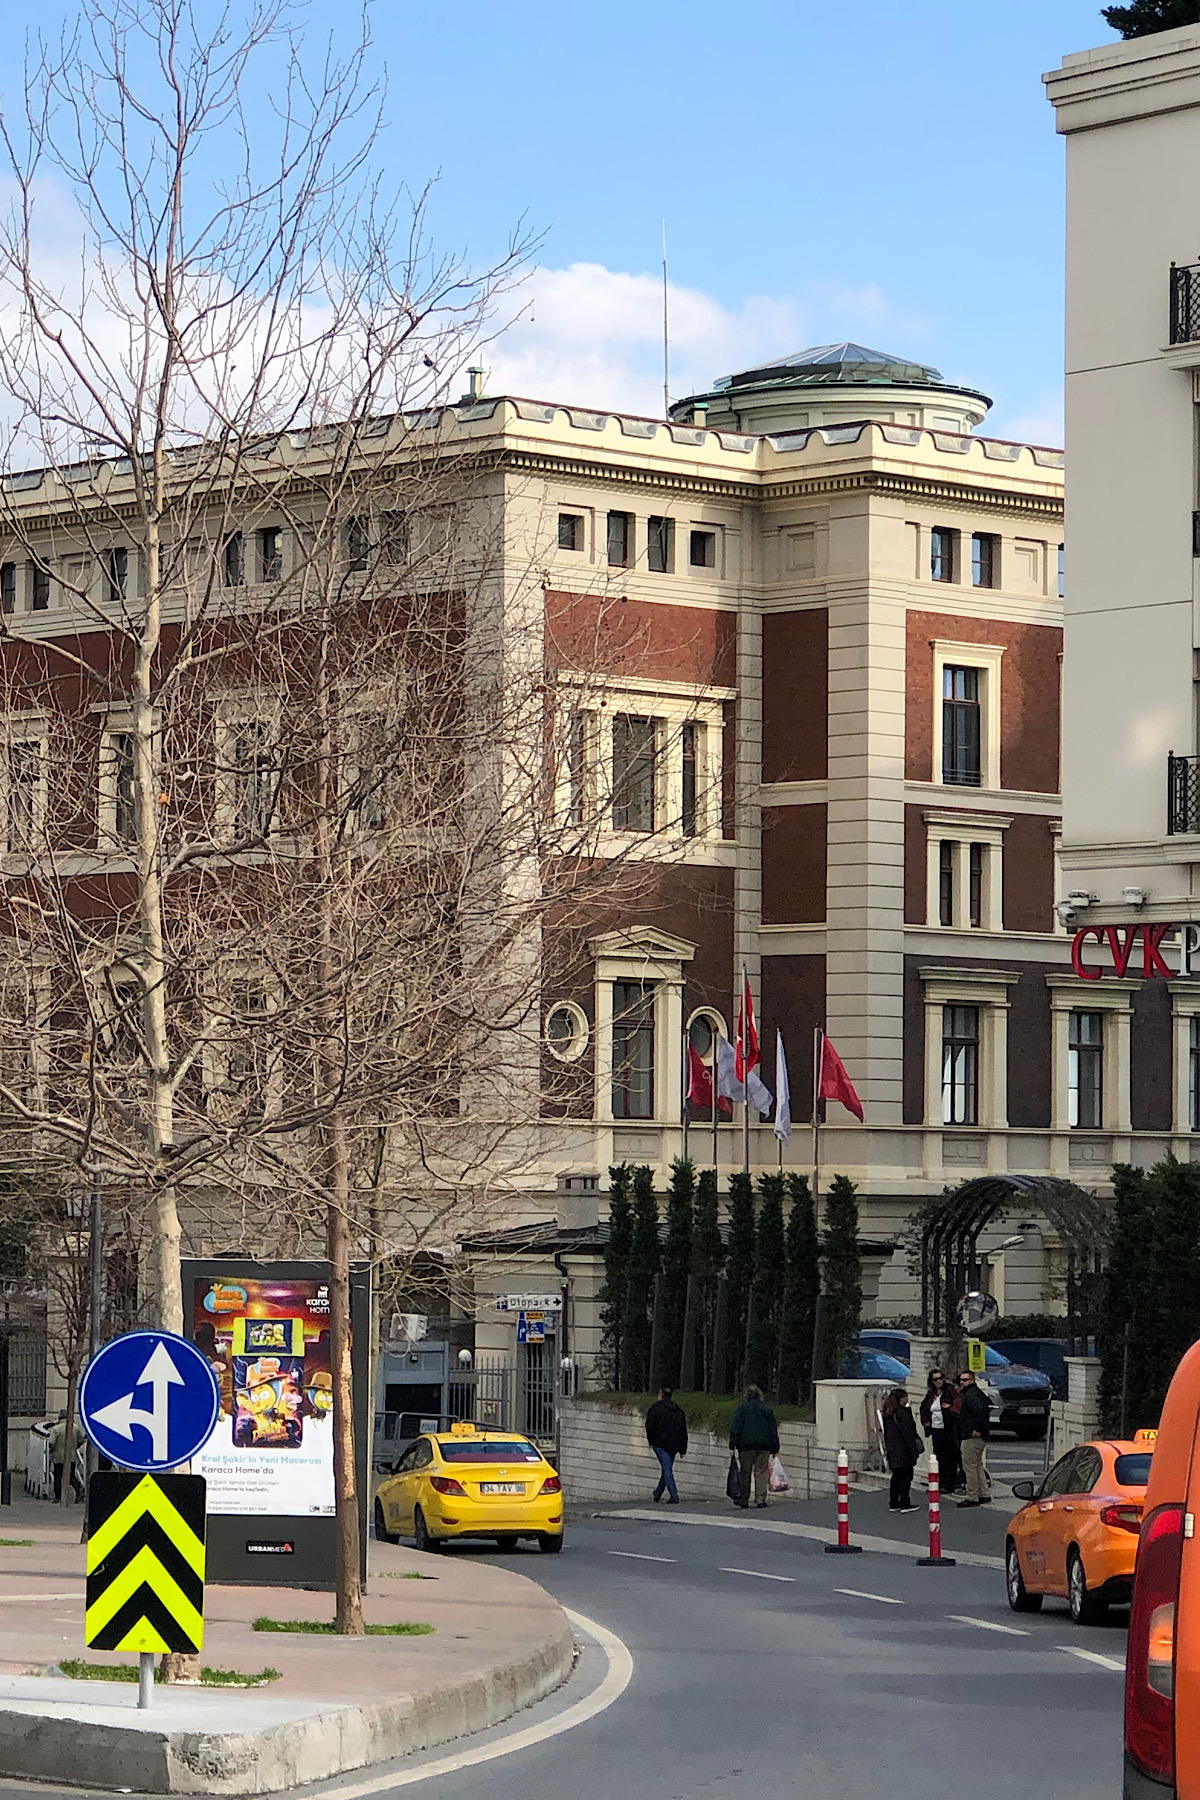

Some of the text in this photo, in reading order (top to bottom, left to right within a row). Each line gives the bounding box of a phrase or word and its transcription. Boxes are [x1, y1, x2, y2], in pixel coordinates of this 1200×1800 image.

[1071, 922, 1176, 980] CVK
[1142, 1431, 1156, 1440] TA
[201, 1455, 220, 1463] Kral
[259, 1456, 279, 1464] Yeni
[201, 1465, 274, 1475] Karaca Home'da
[486, 1484, 495, 1492] 34
[497, 1484, 512, 1493] TAV
